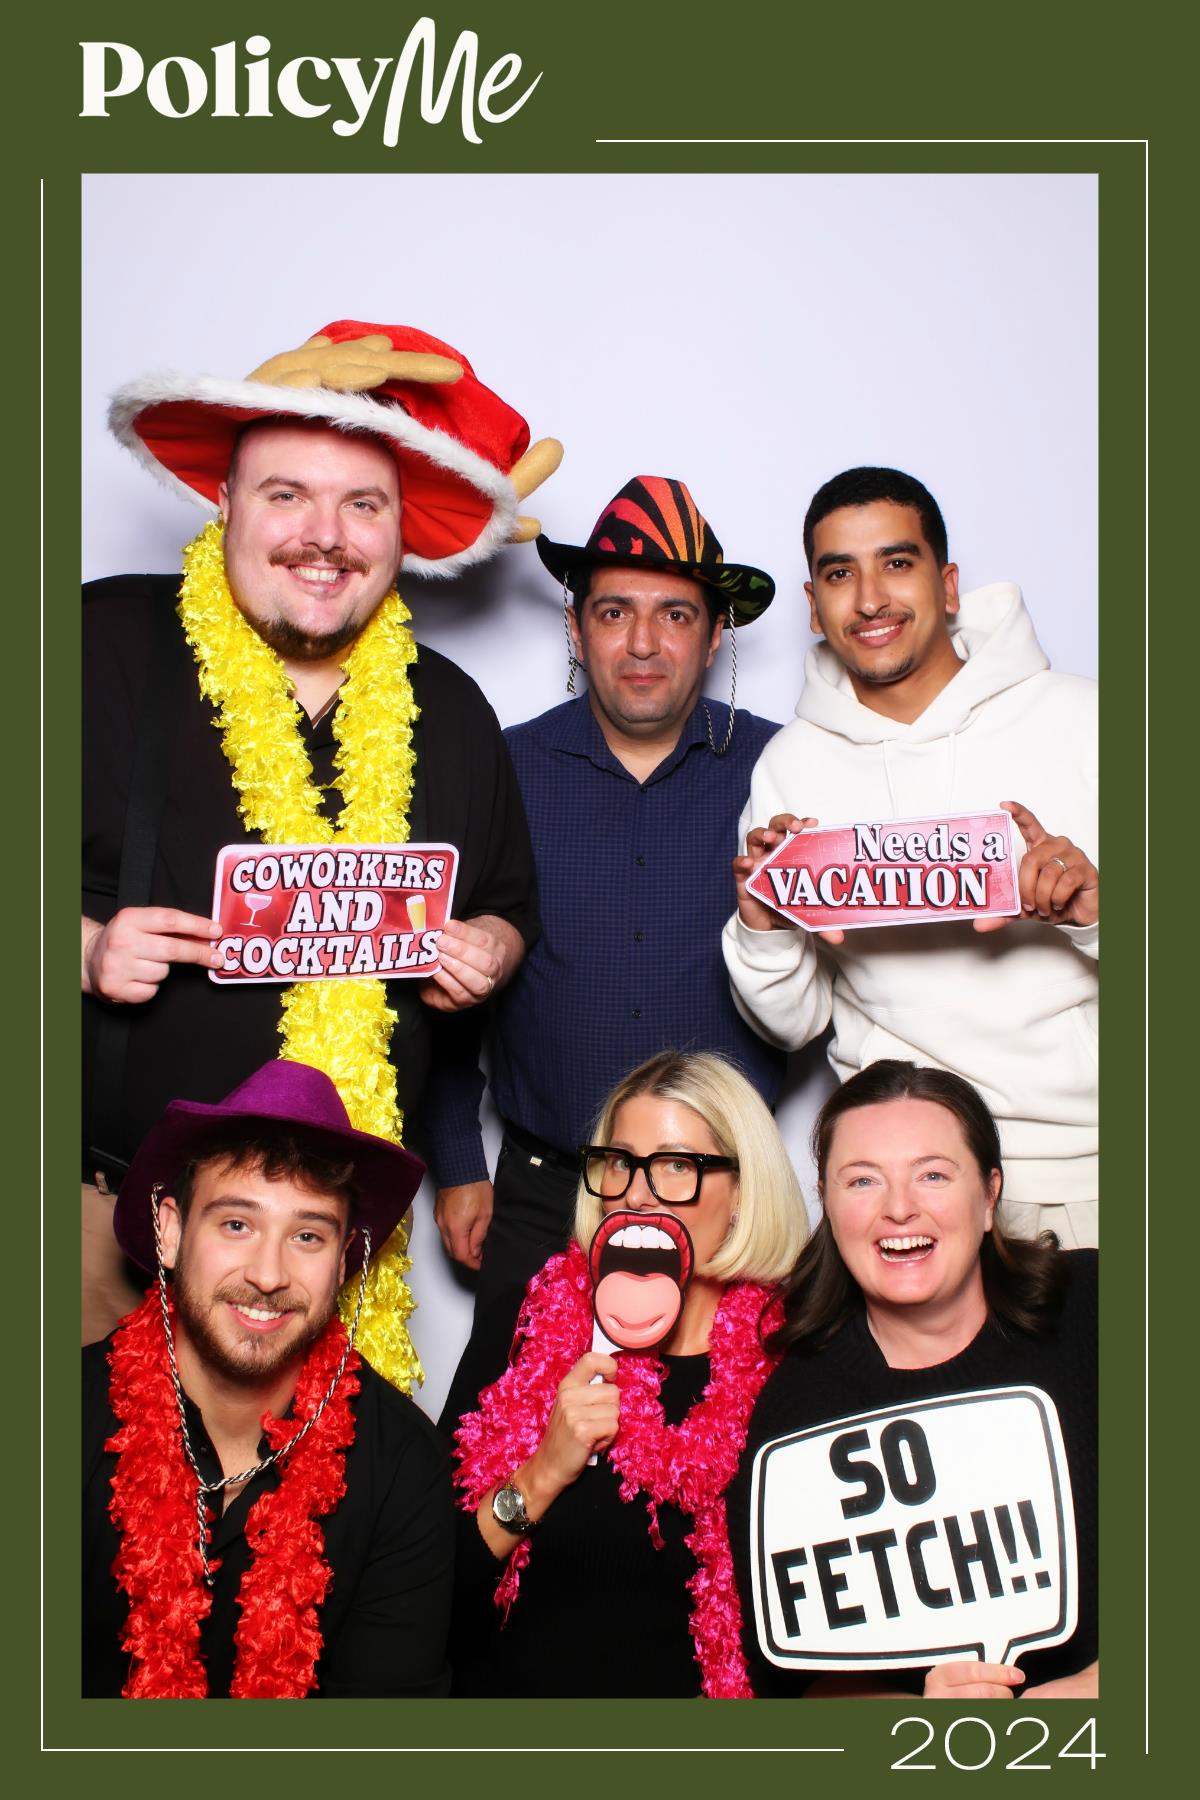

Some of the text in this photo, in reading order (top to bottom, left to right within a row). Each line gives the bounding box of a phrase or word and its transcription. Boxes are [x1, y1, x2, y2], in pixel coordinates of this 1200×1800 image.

[854, 824, 1007, 862] Needs a
[231, 852, 445, 892] COWORKERS
[766, 867, 989, 907] VACATION
[285, 891, 383, 933] AND
[217, 930, 443, 976] COCKTAILS
[829, 1418, 937, 1520] SO
[771, 1499, 1052, 1638] FETCH!!
